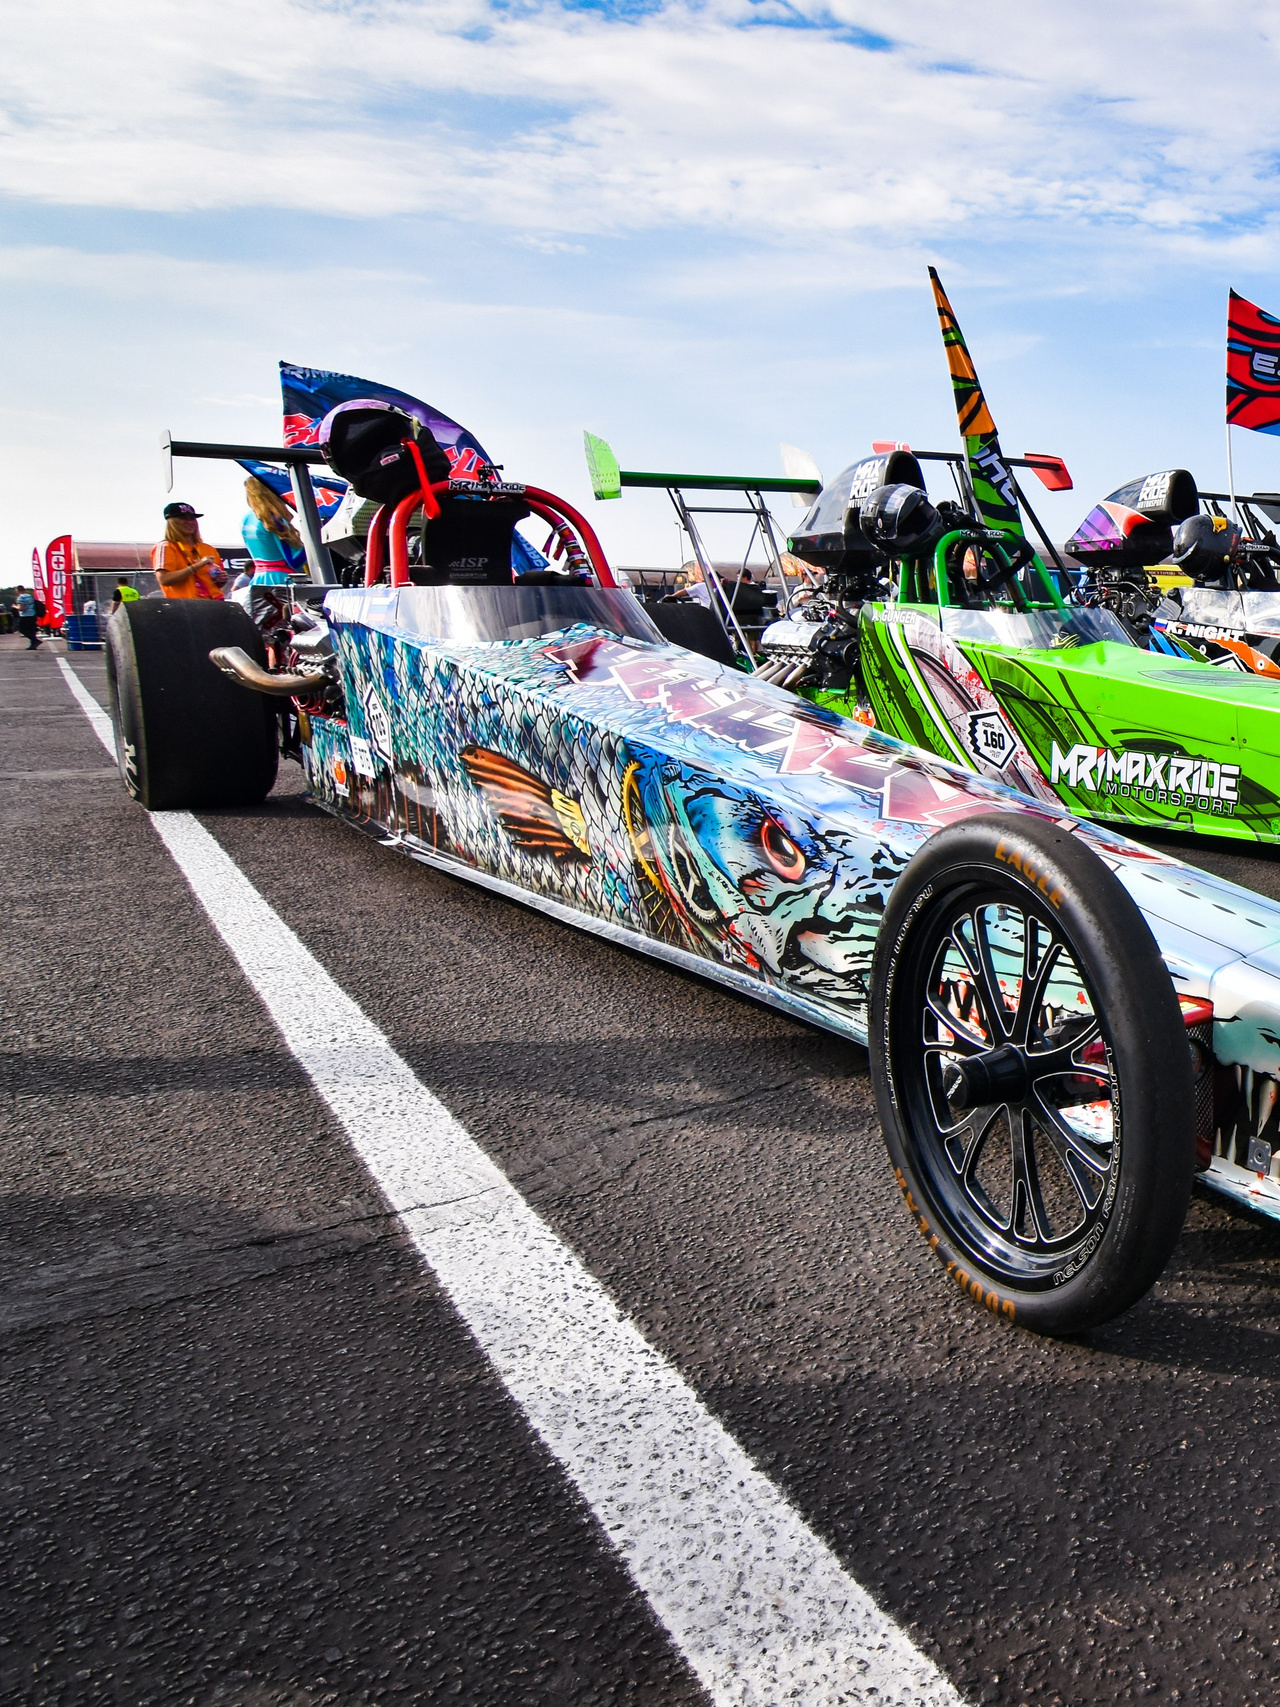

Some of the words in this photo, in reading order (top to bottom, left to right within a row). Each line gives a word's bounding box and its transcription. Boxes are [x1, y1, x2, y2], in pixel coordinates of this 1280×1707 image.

[853, 458, 885, 480] MAX
[1143, 471, 1176, 488] MAX
[1139, 486, 1168, 501] RIDE
[459, 557, 488, 568] ISP
[1185, 624, 1244, 642] NIGHT
[983, 729, 1005, 751] 160
[1105, 780, 1239, 815] MOTORSPORT
[995, 836, 1071, 910] EAGLE
